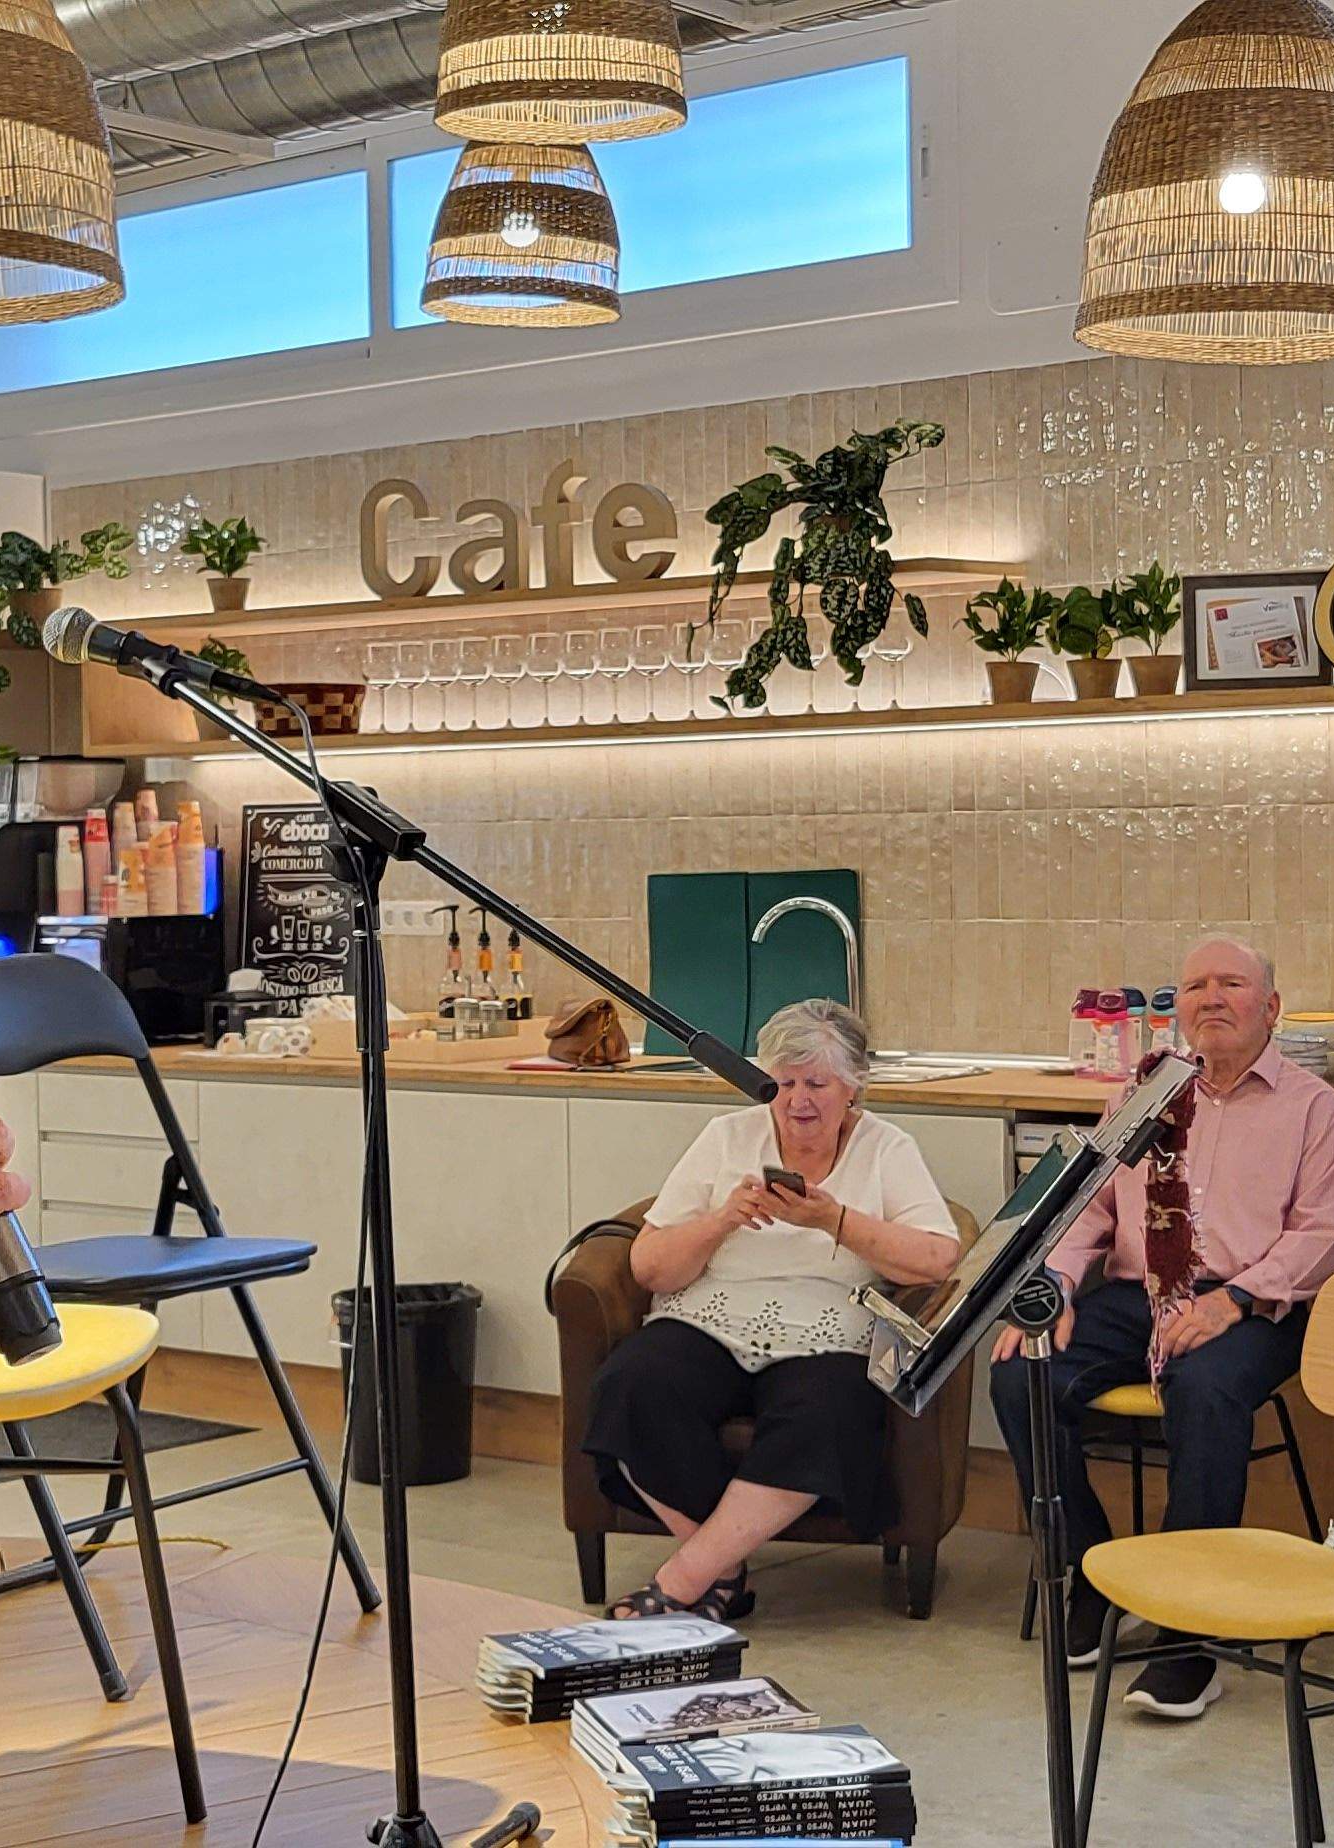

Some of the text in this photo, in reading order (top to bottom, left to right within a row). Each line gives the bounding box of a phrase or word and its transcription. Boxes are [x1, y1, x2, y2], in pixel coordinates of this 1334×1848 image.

[360, 459, 678, 598] Cafe
[280, 819, 329, 842] eboca
[261, 858, 314, 870] COMERCIO
[258, 979, 299, 997] OSTADO
[835, 1789, 870, 1798] JUAN
[838, 1800, 873, 1808] JUAN
[842, 1819, 876, 1828] JUAN
